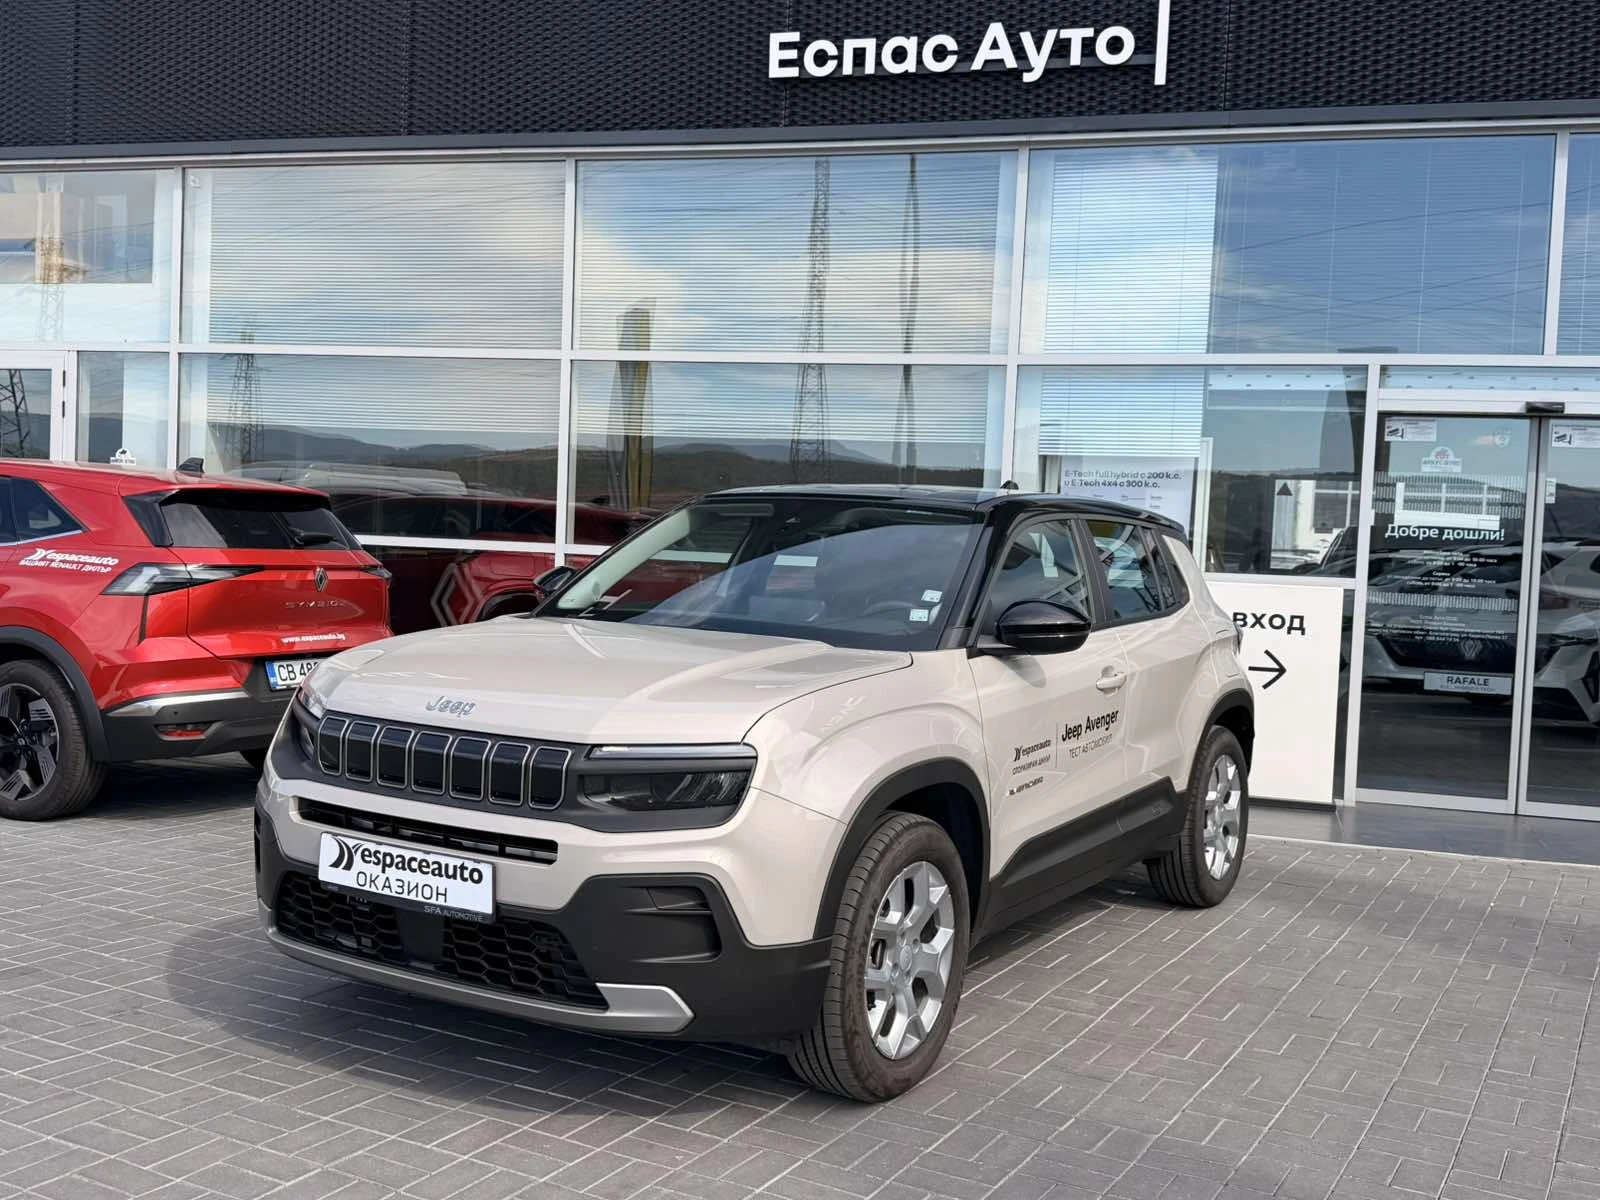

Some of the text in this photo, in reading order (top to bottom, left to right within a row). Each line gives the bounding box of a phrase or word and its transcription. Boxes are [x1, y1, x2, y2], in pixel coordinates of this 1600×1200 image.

[768, 22, 1136, 83] Еспас Ауто
[1385, 525, 1505, 541] Добре дошли!
[46, 551, 119, 566] espaceauto
[299, 661, 318, 676] 48
[1446, 675, 1489, 687] RAFALE
[425, 695, 476, 718] Jeep
[1061, 710, 1119, 742] Jeep Avenger
[360, 847, 484, 885] espaceauto
[356, 871, 448, 903] ОКАЗИОН
